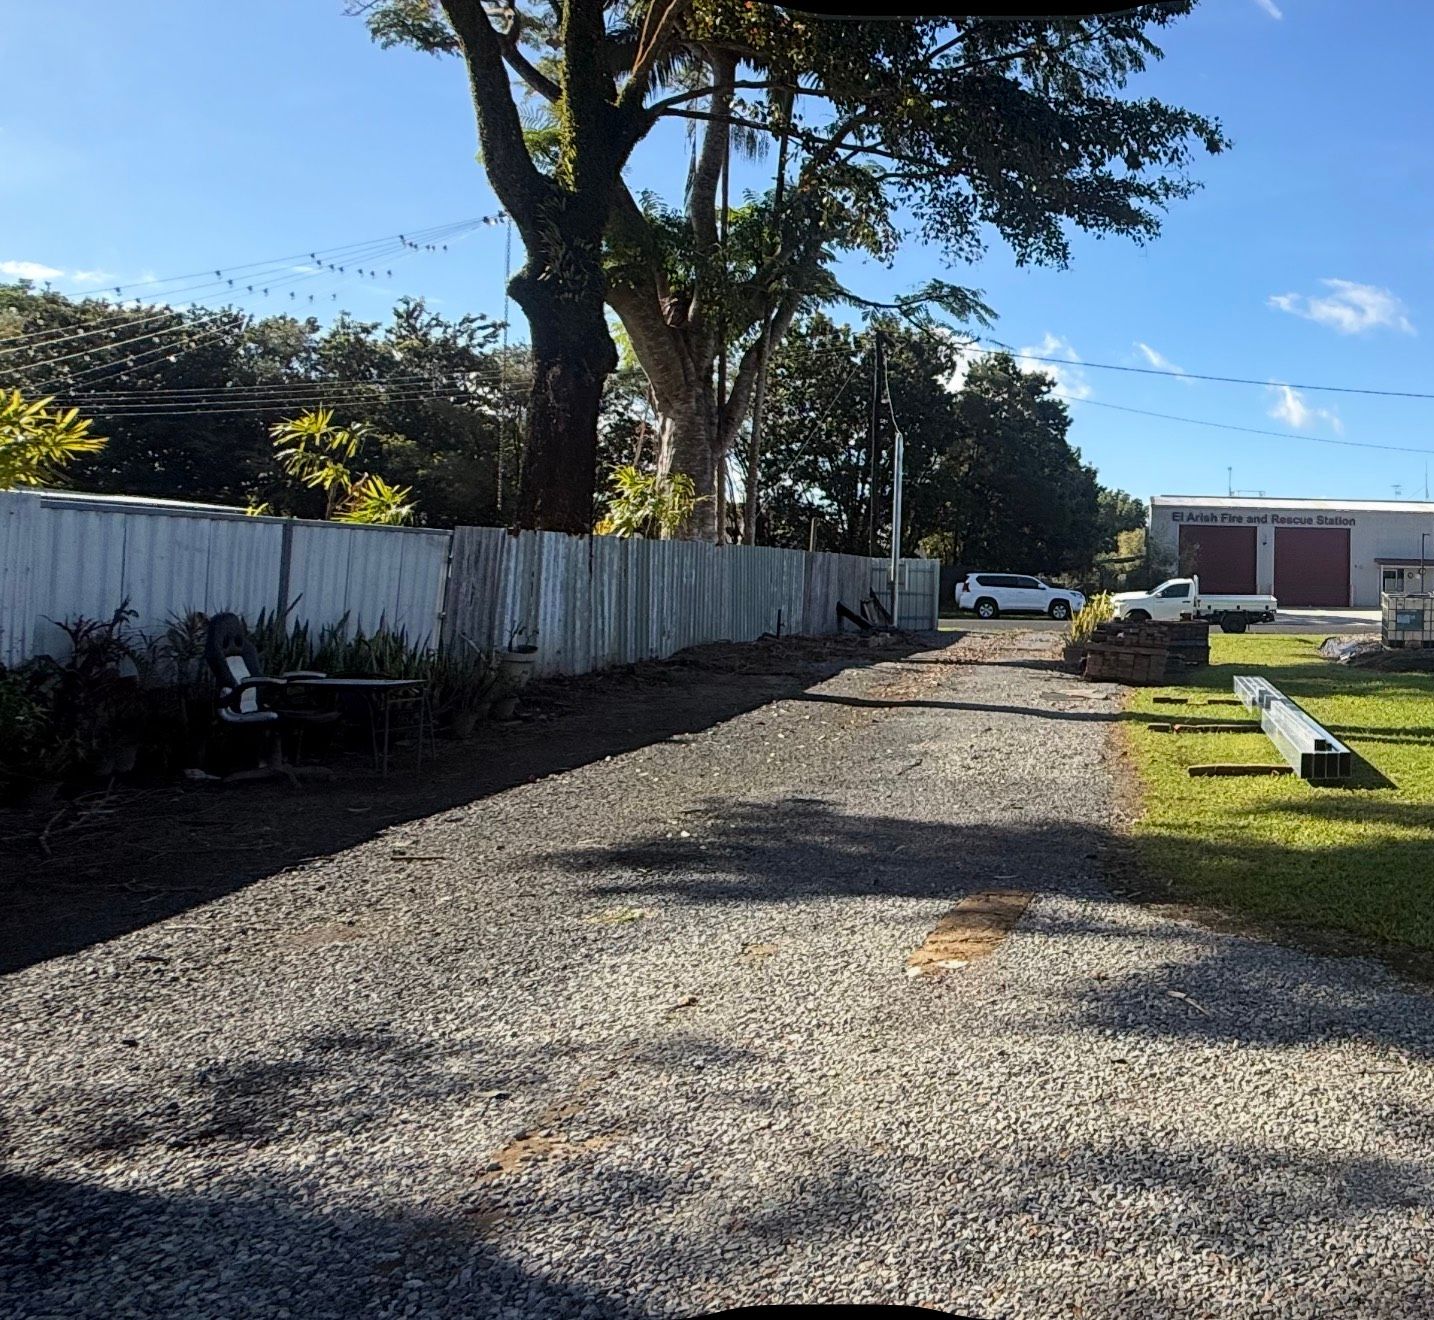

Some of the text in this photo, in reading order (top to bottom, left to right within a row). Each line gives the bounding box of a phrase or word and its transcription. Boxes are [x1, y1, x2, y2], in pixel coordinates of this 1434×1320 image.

[1172, 511, 1355, 526] El Arish Fire and Rescue Station
